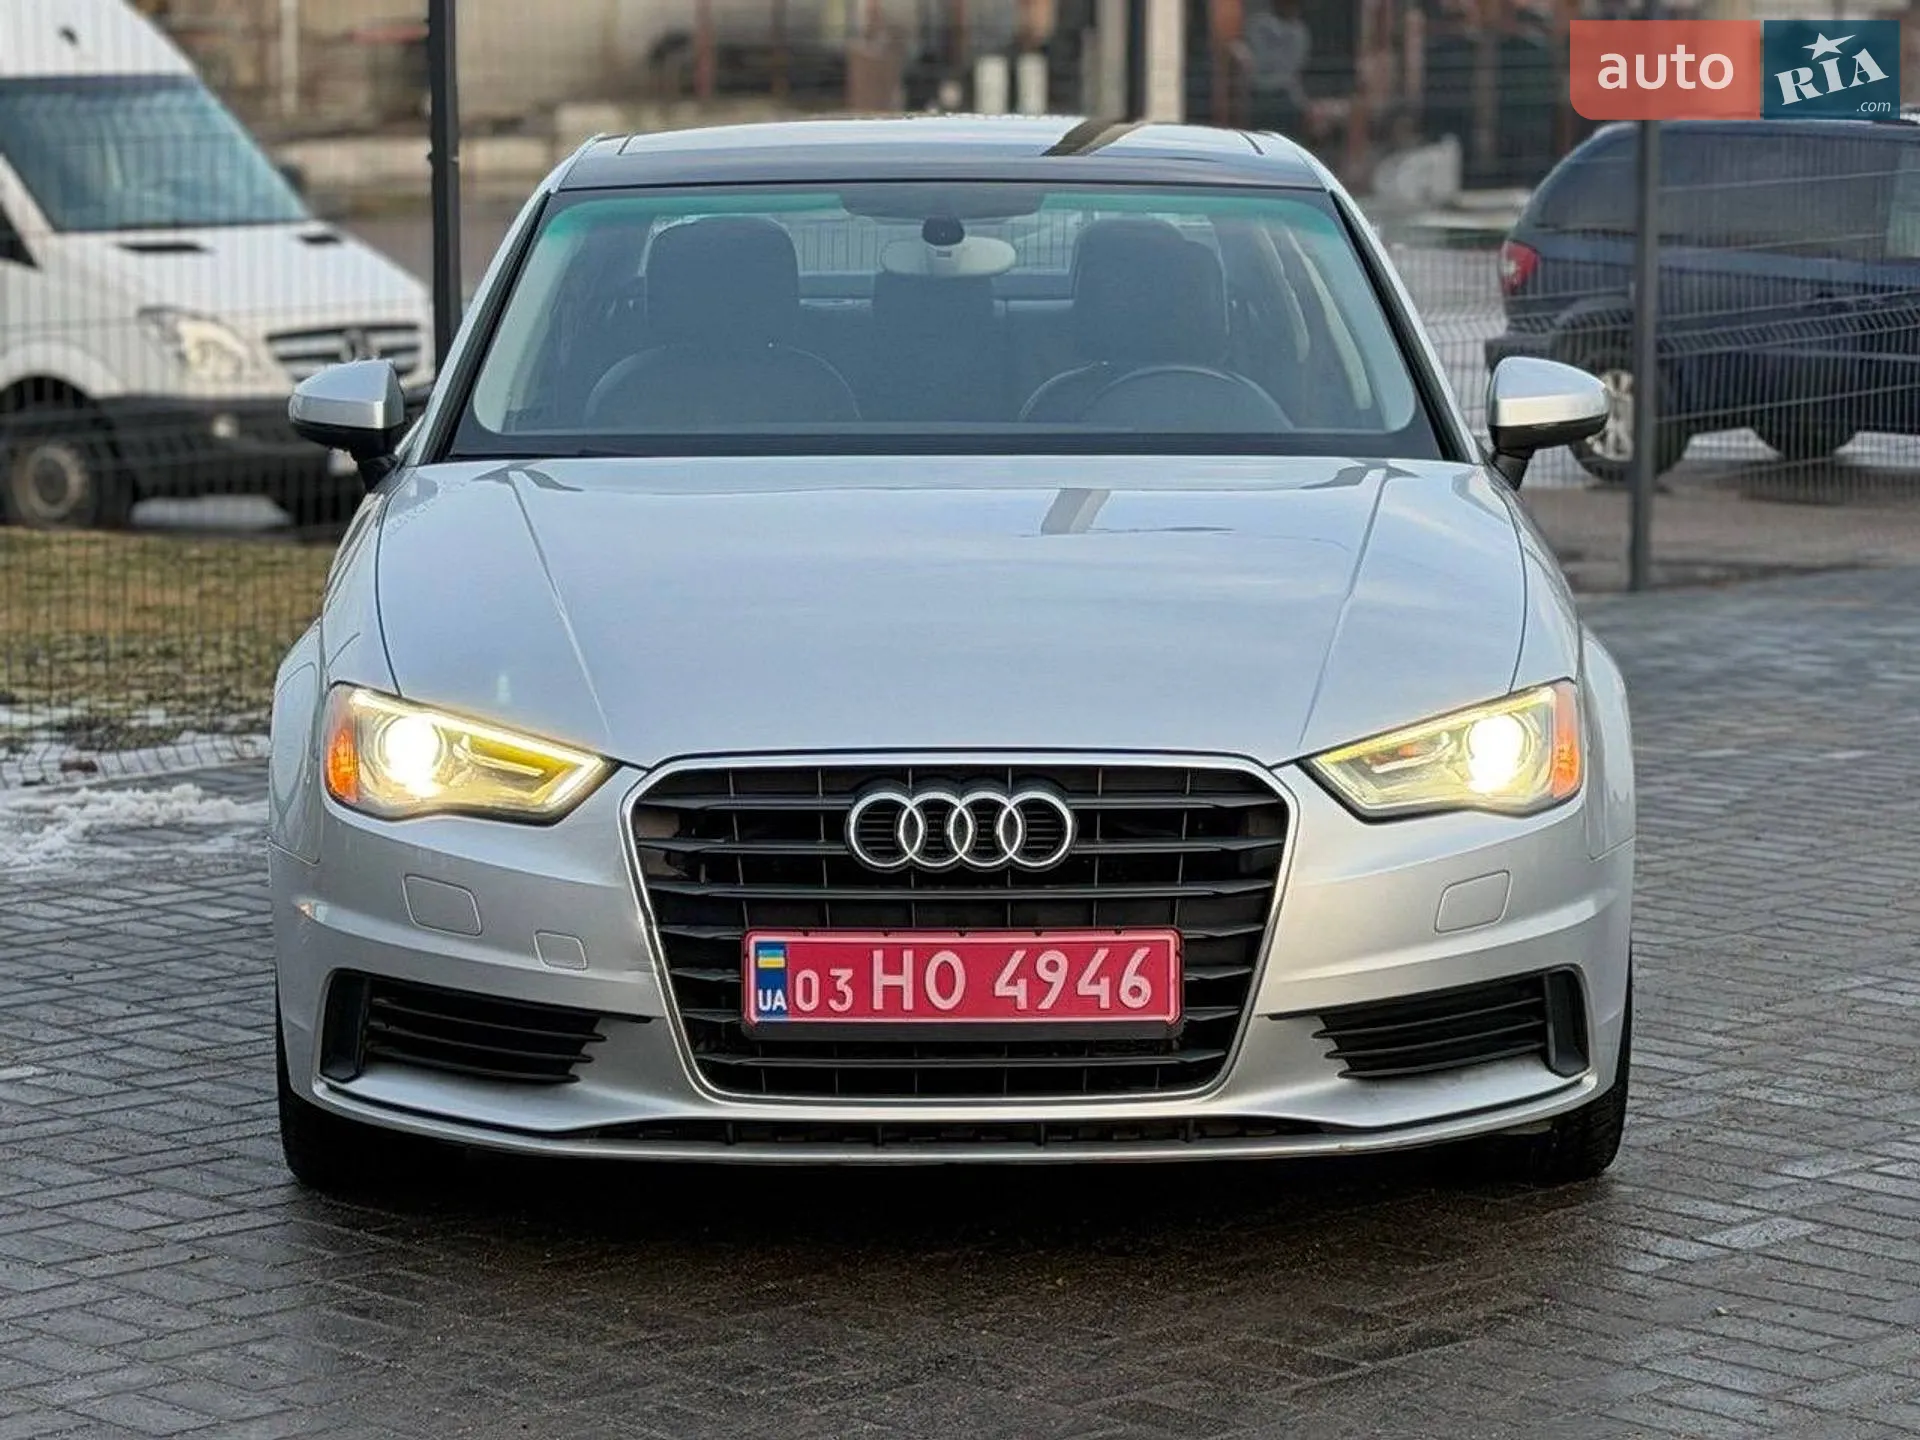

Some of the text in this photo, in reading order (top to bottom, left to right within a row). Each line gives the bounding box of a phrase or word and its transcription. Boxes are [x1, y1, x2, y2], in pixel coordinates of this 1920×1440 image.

[758, 989, 788, 1012] UA
[794, 947, 1153, 1013] 03 HO 4946
